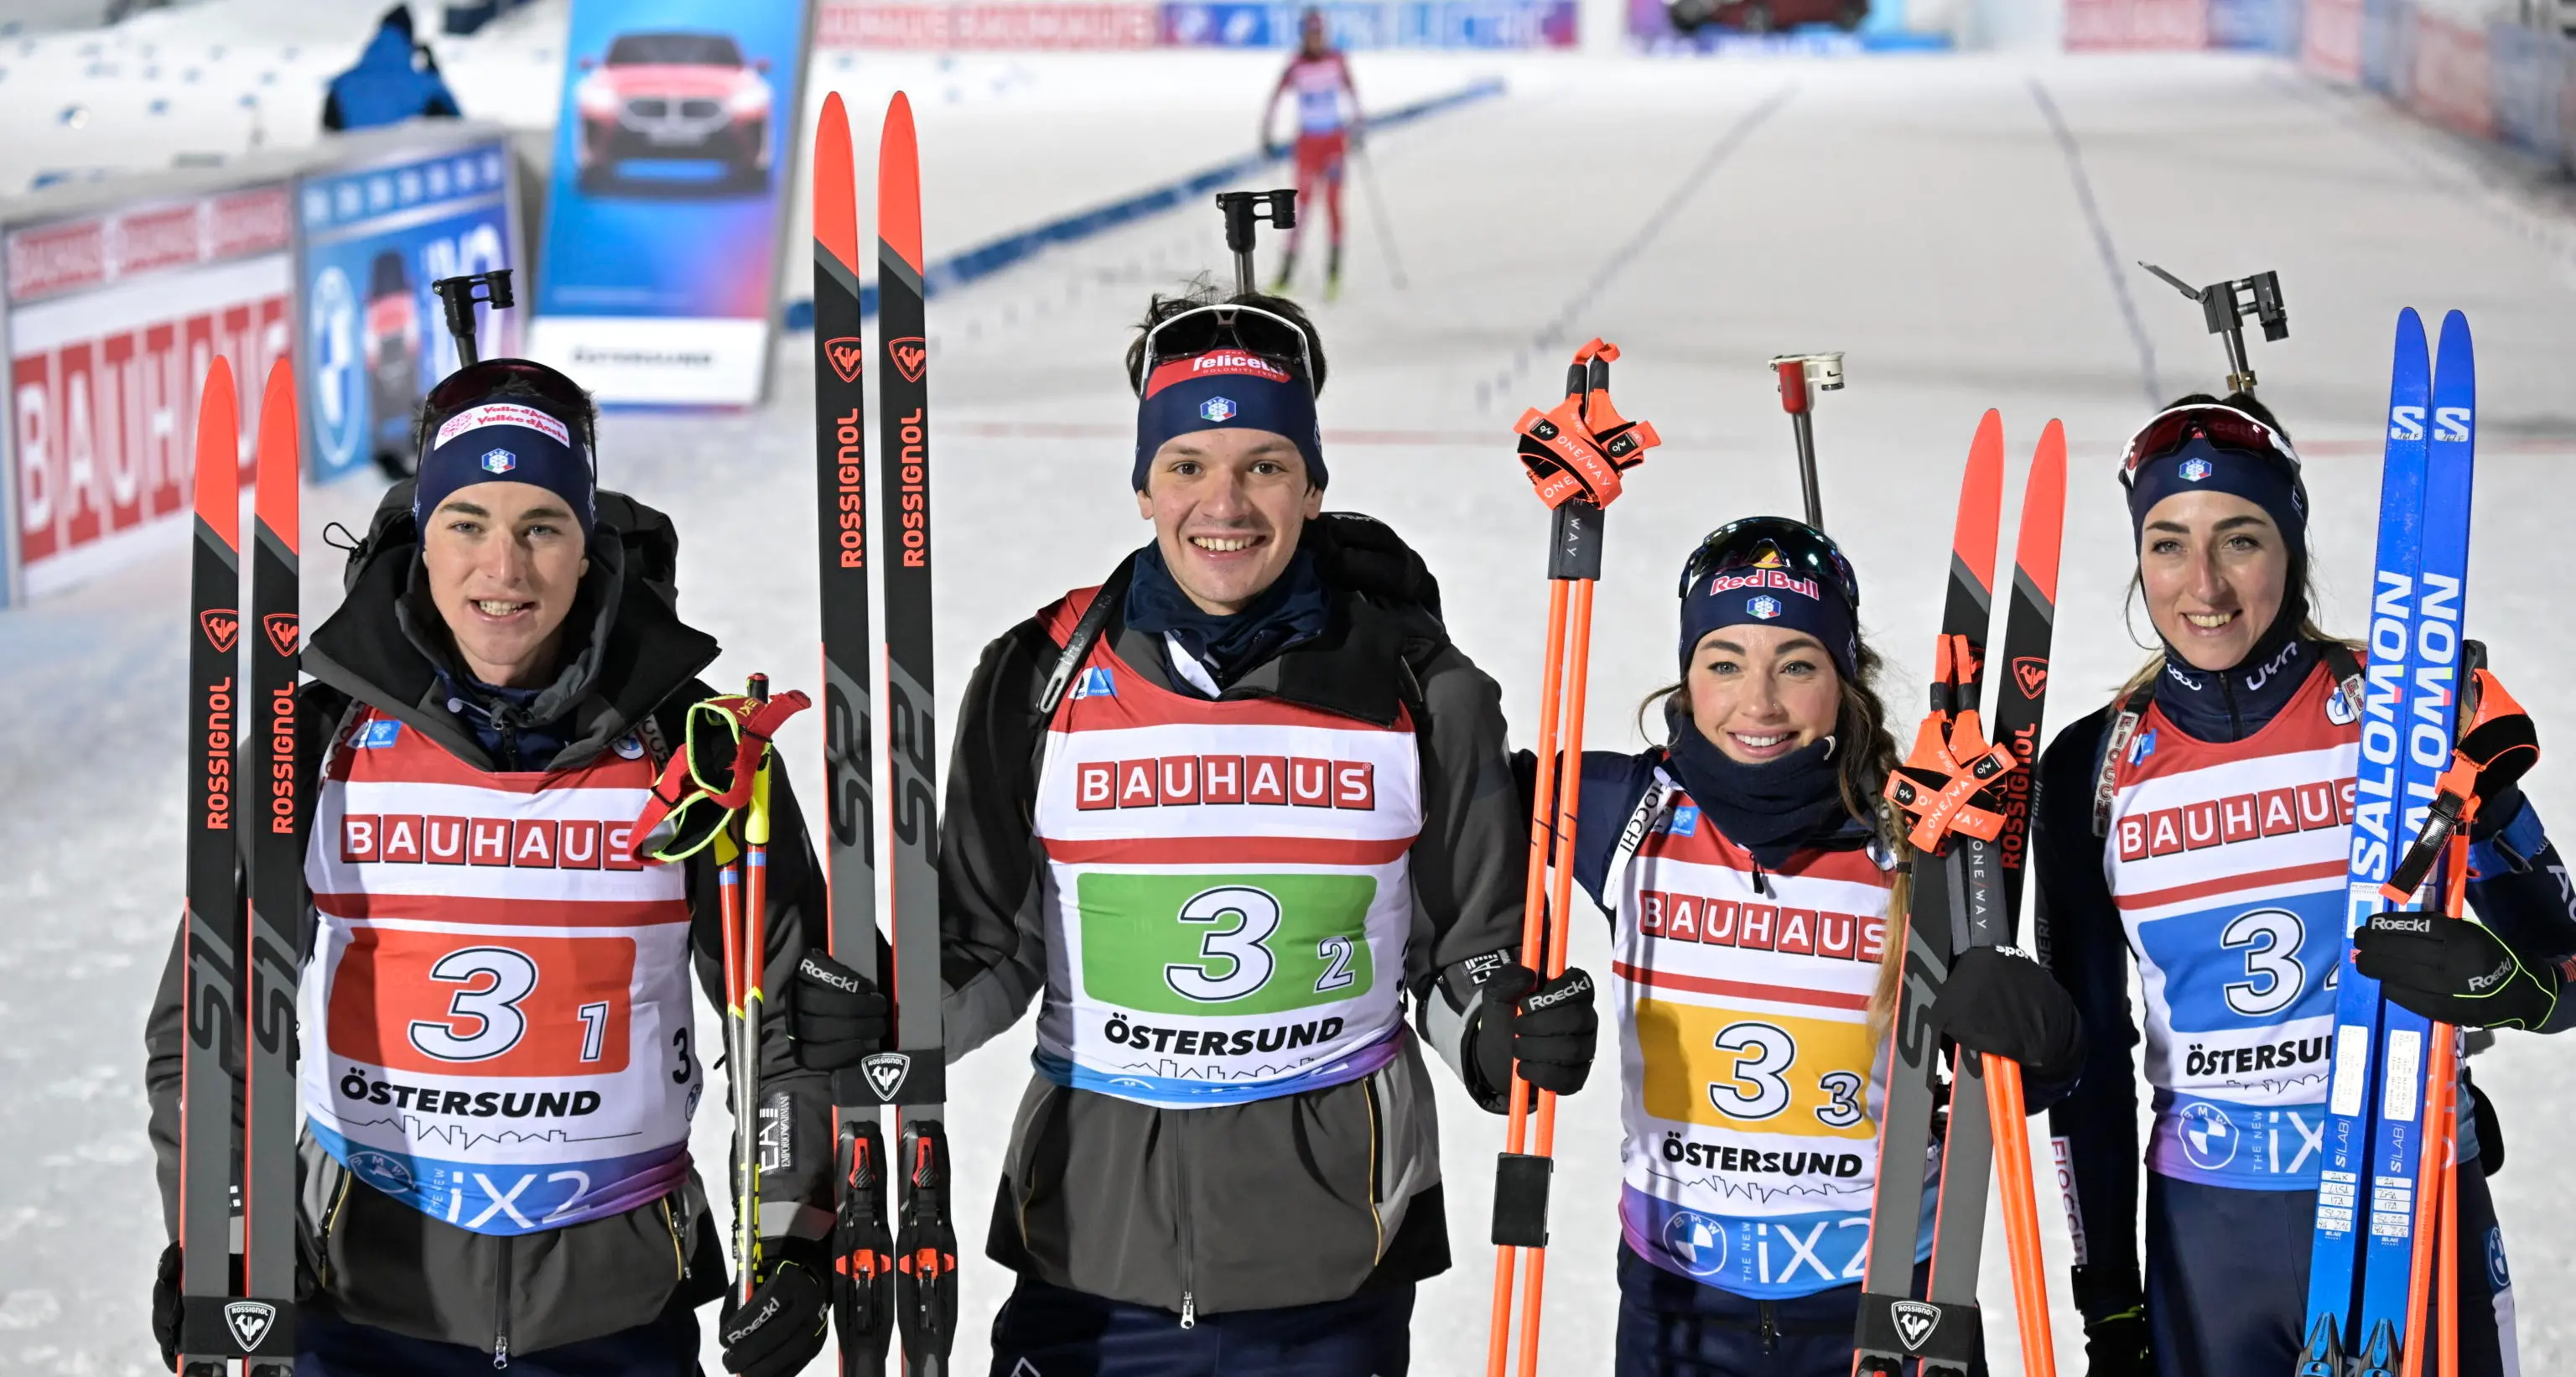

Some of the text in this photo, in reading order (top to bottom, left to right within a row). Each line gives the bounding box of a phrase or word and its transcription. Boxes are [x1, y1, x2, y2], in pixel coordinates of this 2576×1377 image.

[837, 408, 863, 568] ROSSIGNOL
[901, 408, 925, 568] ROSSIGNOL
[1710, 569, 1820, 600] Red Bull
[207, 676, 231, 829] ROSSIGNOL
[2351, 570, 2412, 881] SALOMON
[273, 681, 295, 834] ROSSIGNOL
[1083, 761, 1368, 803] BAUHAUS
[346, 820, 633, 863] BAUHAUS
[1620, 785, 1665, 853] IOCCHI
[1163, 884, 1356, 1003] 3 2
[1644, 896, 1885, 955] BAUHAUS
[2220, 907, 2305, 1016] 3
[408, 945, 610, 1063] 3 1
[673, 1027, 691, 1084] 3
[868, 1057, 903, 1067] ROSSIGNOL
[1104, 1011, 1345, 1057] ÖSTERSUND
[2185, 1037, 2333, 1078] ÖSTERSU
[340, 1067, 601, 1117] ÖSTERSUND
[1707, 1021, 1863, 1128] 3 3
[1662, 1130, 1863, 1178] ÖSTERSUND
[2251, 1111, 2263, 1172] THE NEW
[446, 1171, 593, 1229] iX2
[1742, 1221, 1752, 1281] THE NEW
[231, 1307, 268, 1317] ROSSIGNOL
[1898, 1305, 1935, 1317] ROSSIGNOL
